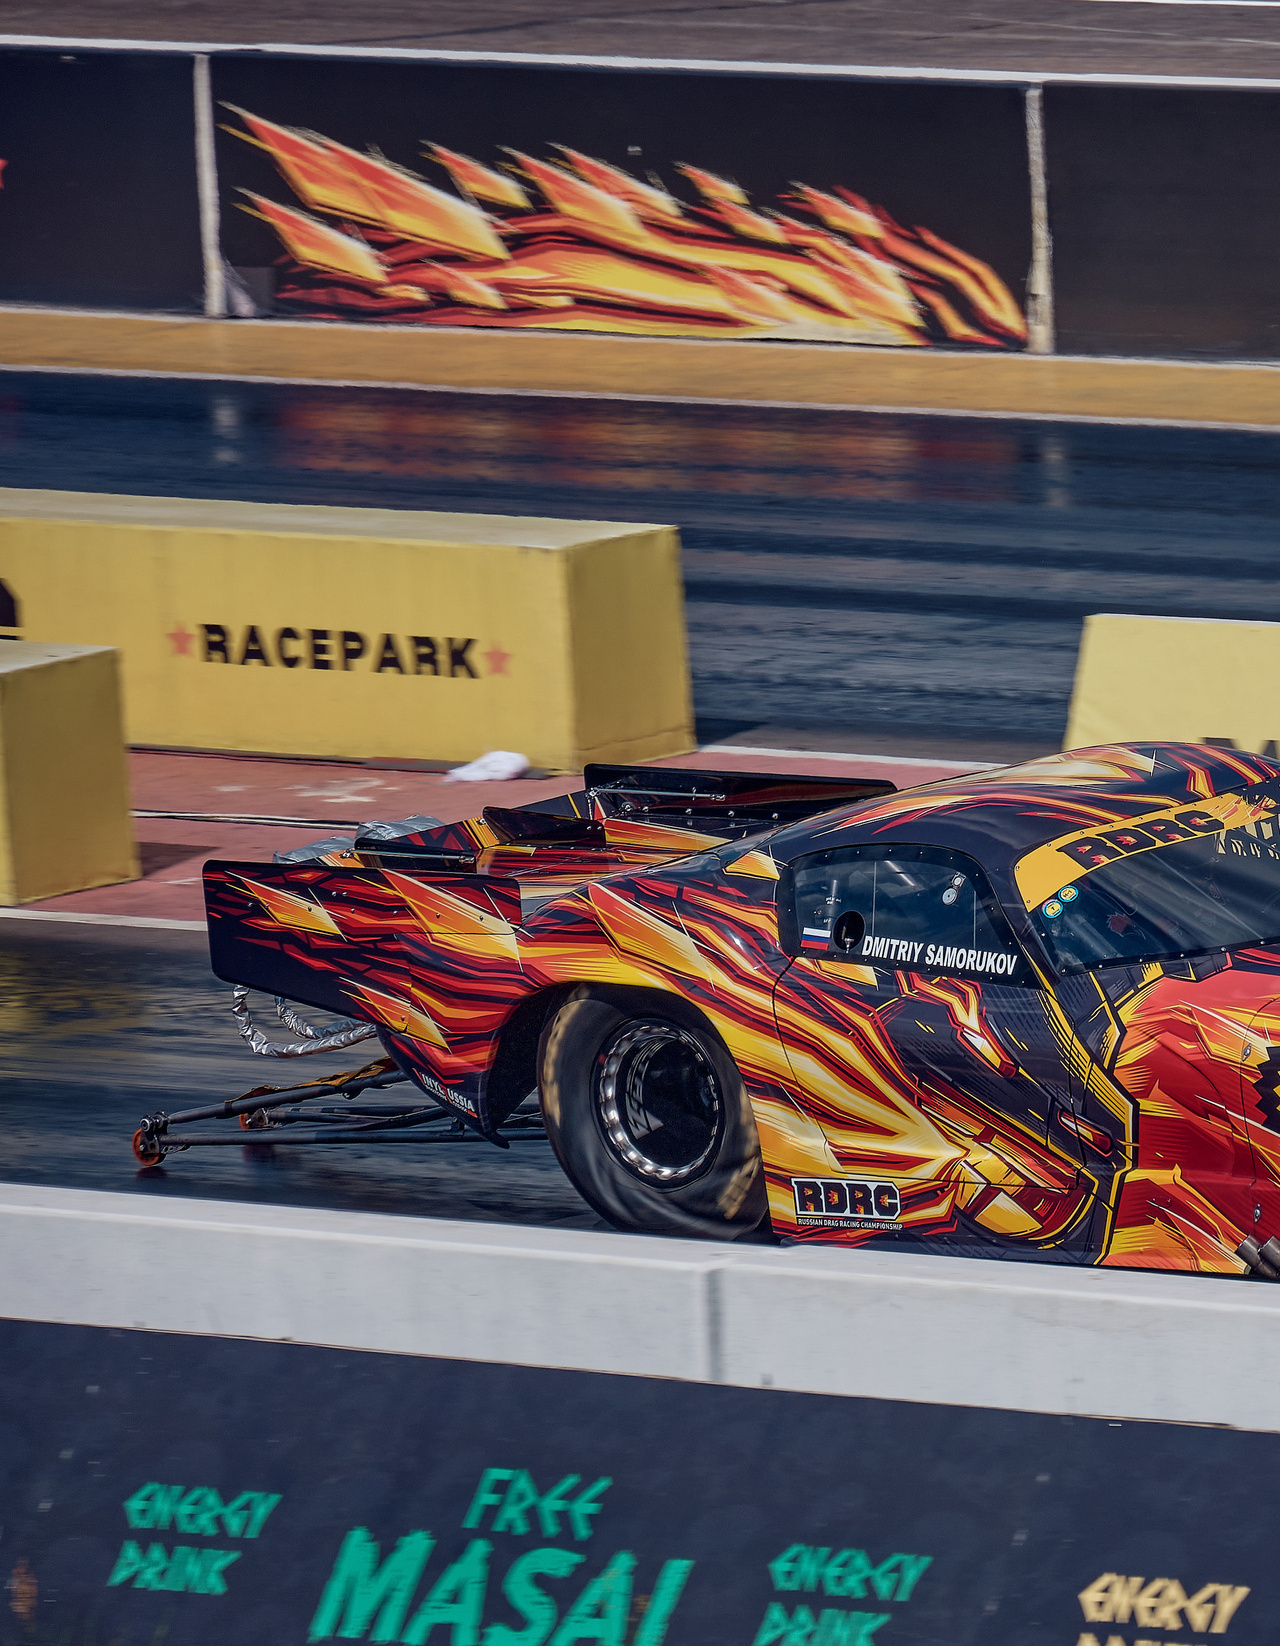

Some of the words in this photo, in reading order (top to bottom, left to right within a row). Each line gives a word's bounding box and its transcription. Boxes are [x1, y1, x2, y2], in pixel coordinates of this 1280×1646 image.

[196, 623, 482, 679] RACEPARK
[1056, 810, 1225, 871] RDRC
[862, 935, 924, 963] DMITRIY
[925, 944, 1017, 976] SAMORUKOV
[794, 1180, 900, 1218] RDRC
[798, 1218, 823, 1227] RUSSIAN
[823, 1219, 839, 1227] DRAG
[839, 1220, 860, 1228] RACING
[860, 1221, 903, 1231] CHAMPIONSHIP
[123, 1481, 283, 1539] ENERGY
[461, 1467, 612, 1541] FREE
[106, 1539, 243, 1595] DRINK
[767, 1543, 934, 1601] ENERGY
[1077, 1572, 1251, 1634] ENERGY
